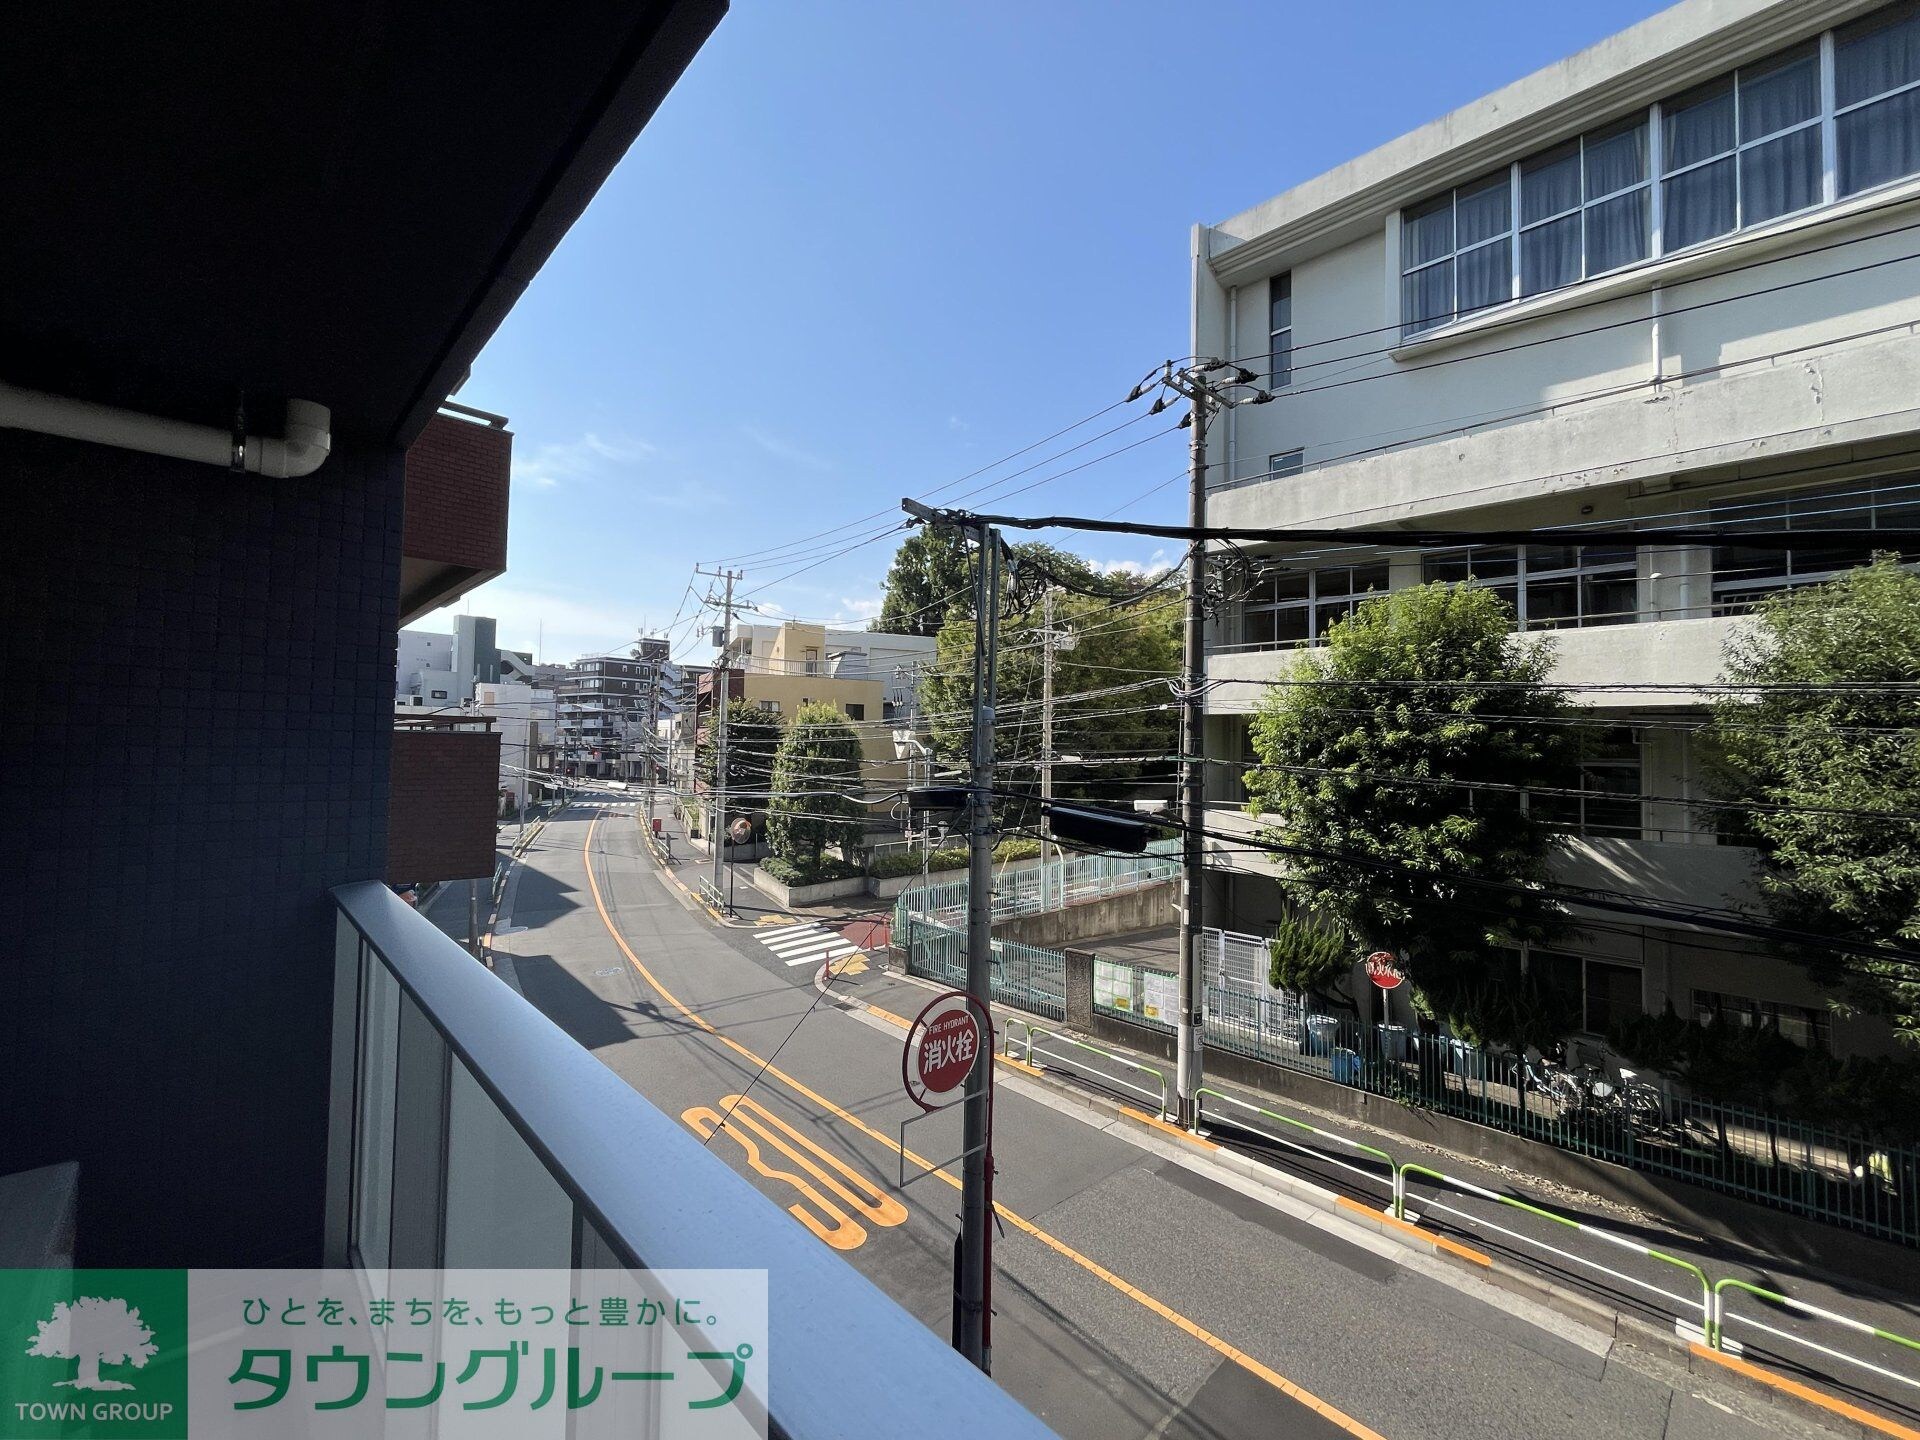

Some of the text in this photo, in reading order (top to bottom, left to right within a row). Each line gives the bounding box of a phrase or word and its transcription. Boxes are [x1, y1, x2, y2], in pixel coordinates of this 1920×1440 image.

[928, 1015, 970, 1035] FIRE HYDRANT
[923, 1028, 975, 1075] 消火栓
